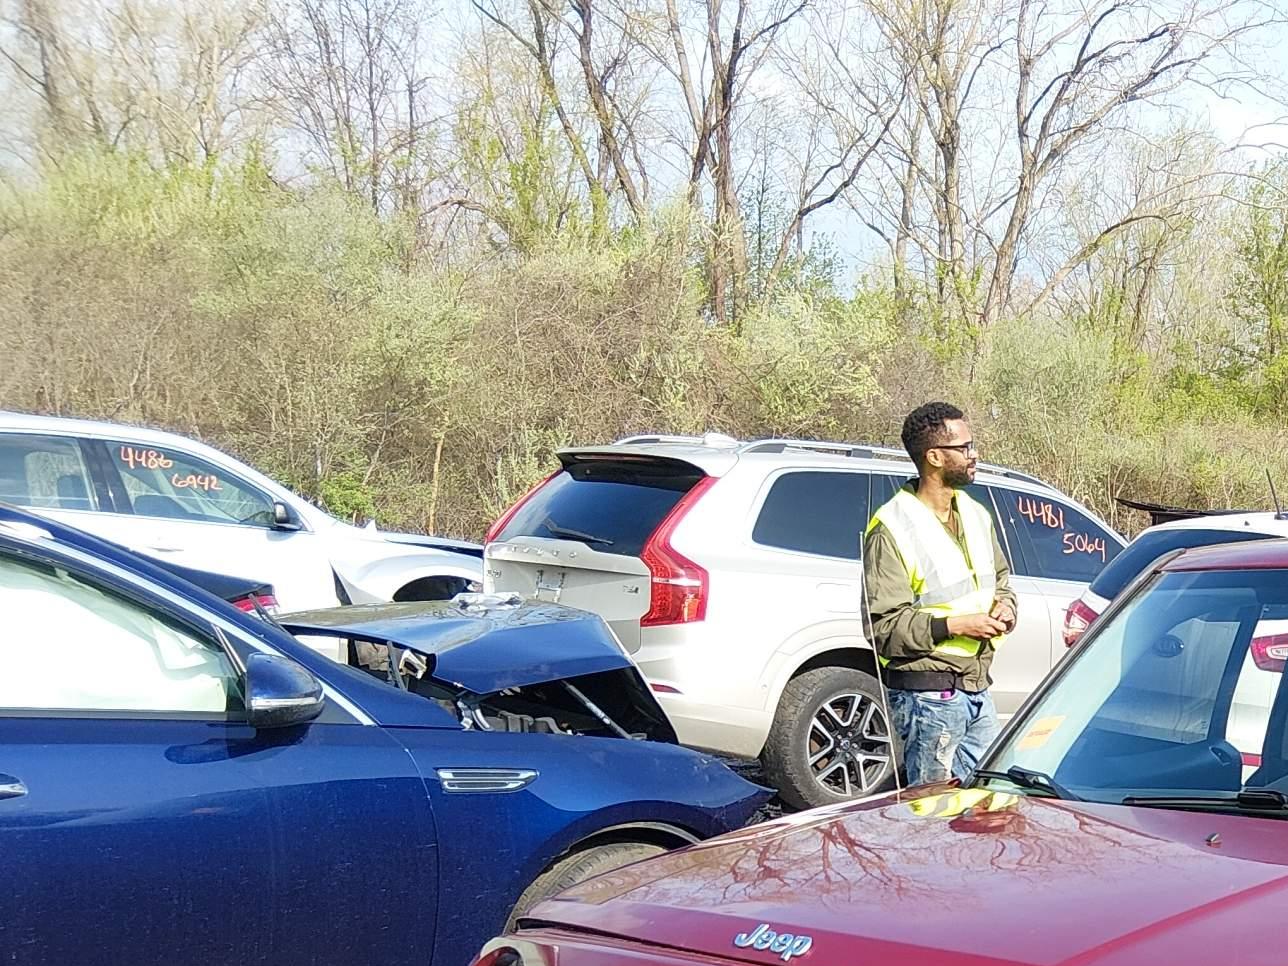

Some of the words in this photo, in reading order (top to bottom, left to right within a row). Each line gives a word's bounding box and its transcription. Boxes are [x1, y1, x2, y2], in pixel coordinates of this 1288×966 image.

[121, 446, 173, 470] 4486
[172, 472, 223, 491] 6942
[1018, 495, 1065, 530] 4481
[1062, 532, 1106, 563] 5064
[734, 923, 813, 961] Jeep
